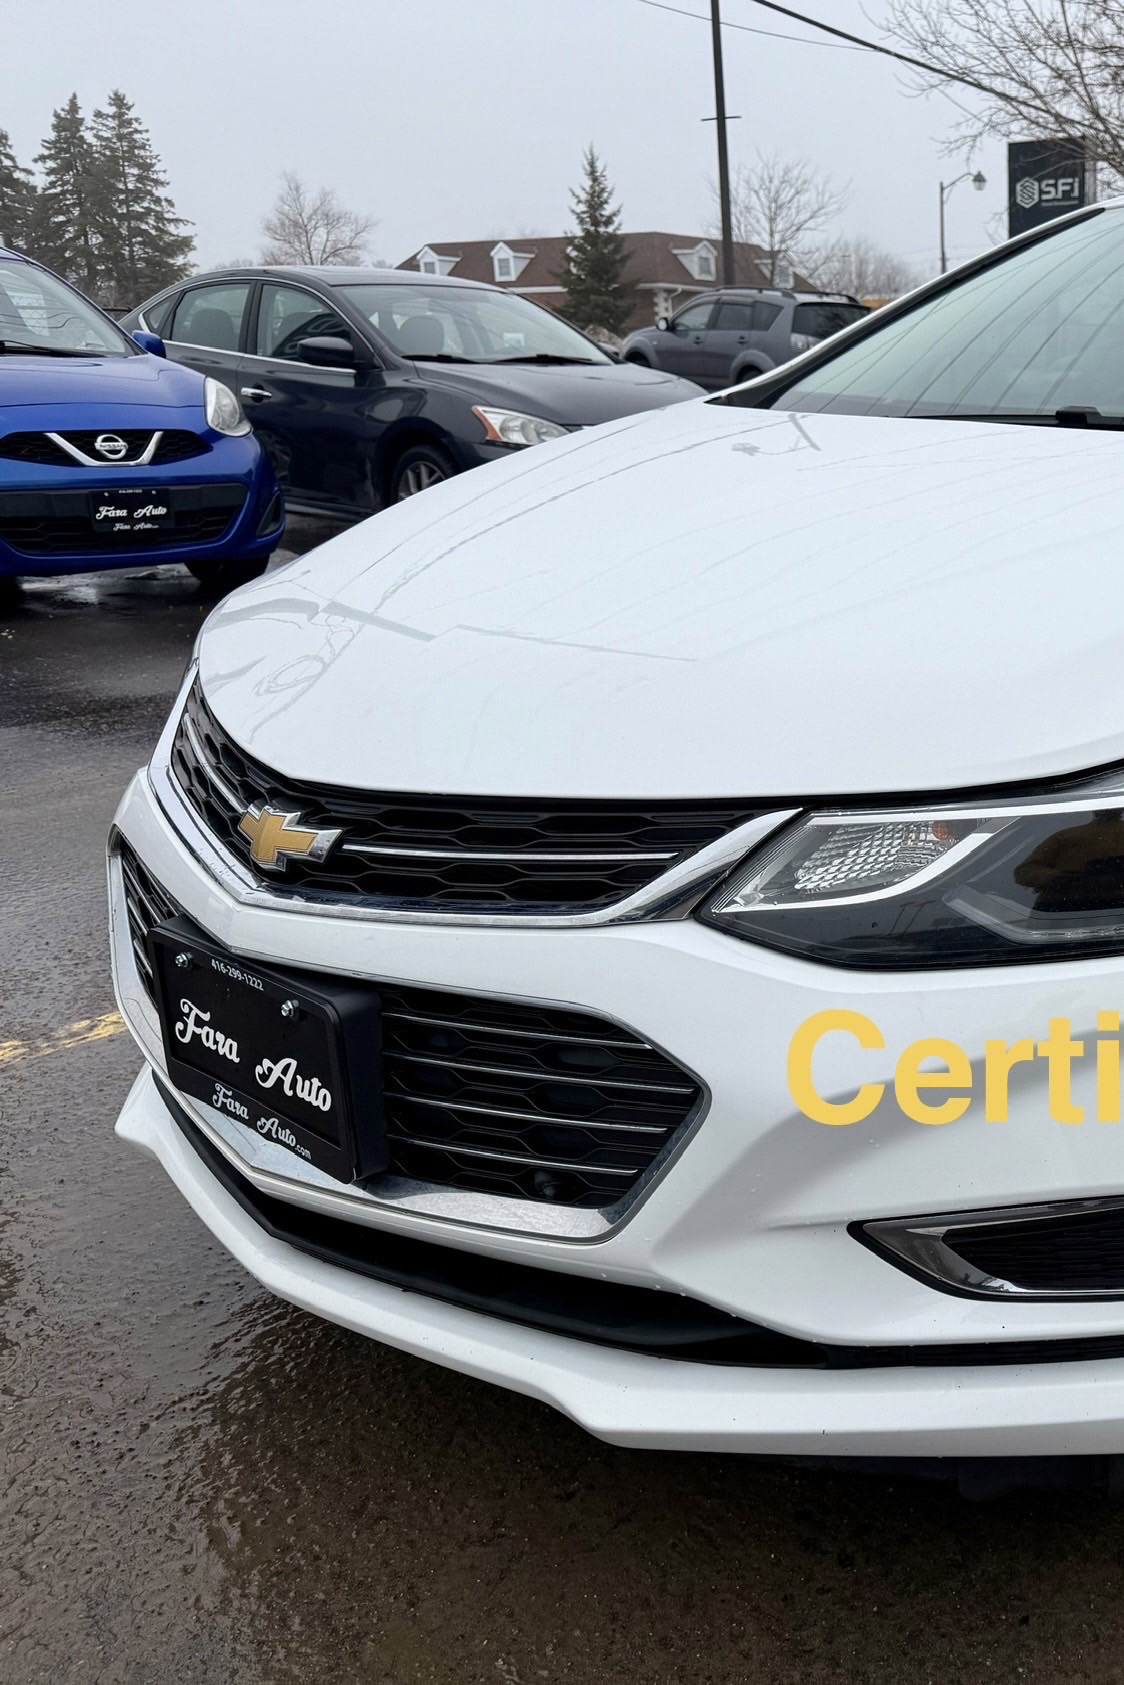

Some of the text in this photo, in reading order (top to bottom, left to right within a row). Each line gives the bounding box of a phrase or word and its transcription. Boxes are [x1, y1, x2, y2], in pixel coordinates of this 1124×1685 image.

[95, 504, 167, 520] Fara Auto
[211, 959, 264, 991] 416-299-1222
[175, 998, 332, 1112] Fara Auto
[212, 1083, 249, 1120] Fara
